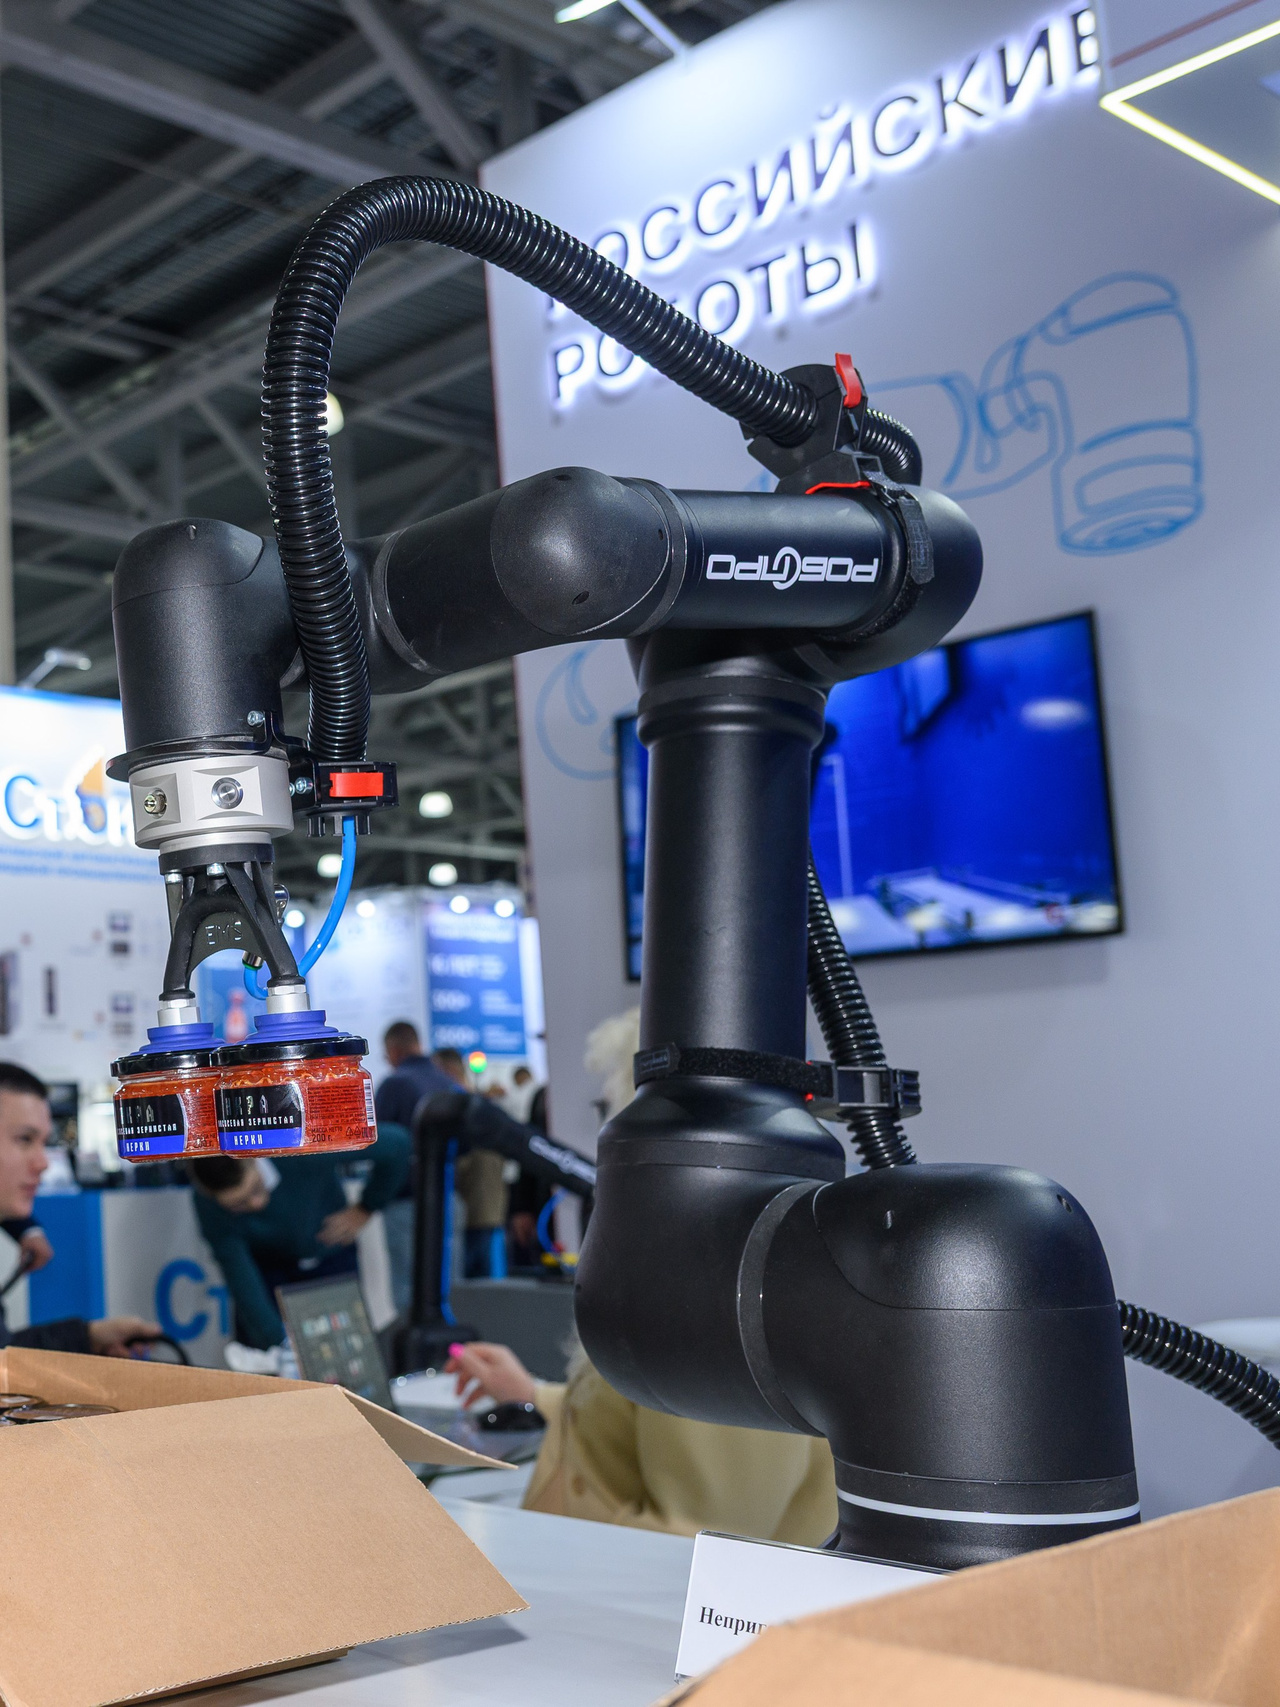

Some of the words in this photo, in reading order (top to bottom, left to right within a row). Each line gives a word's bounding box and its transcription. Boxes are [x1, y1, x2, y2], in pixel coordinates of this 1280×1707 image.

[547, 8, 1097, 312] ОССИЙСКИЕ
[552, 222, 864, 398] РООТЫ
[233, 1133, 263, 1146] НЕРКИ
[312, 1133, 326, 1143] 200
